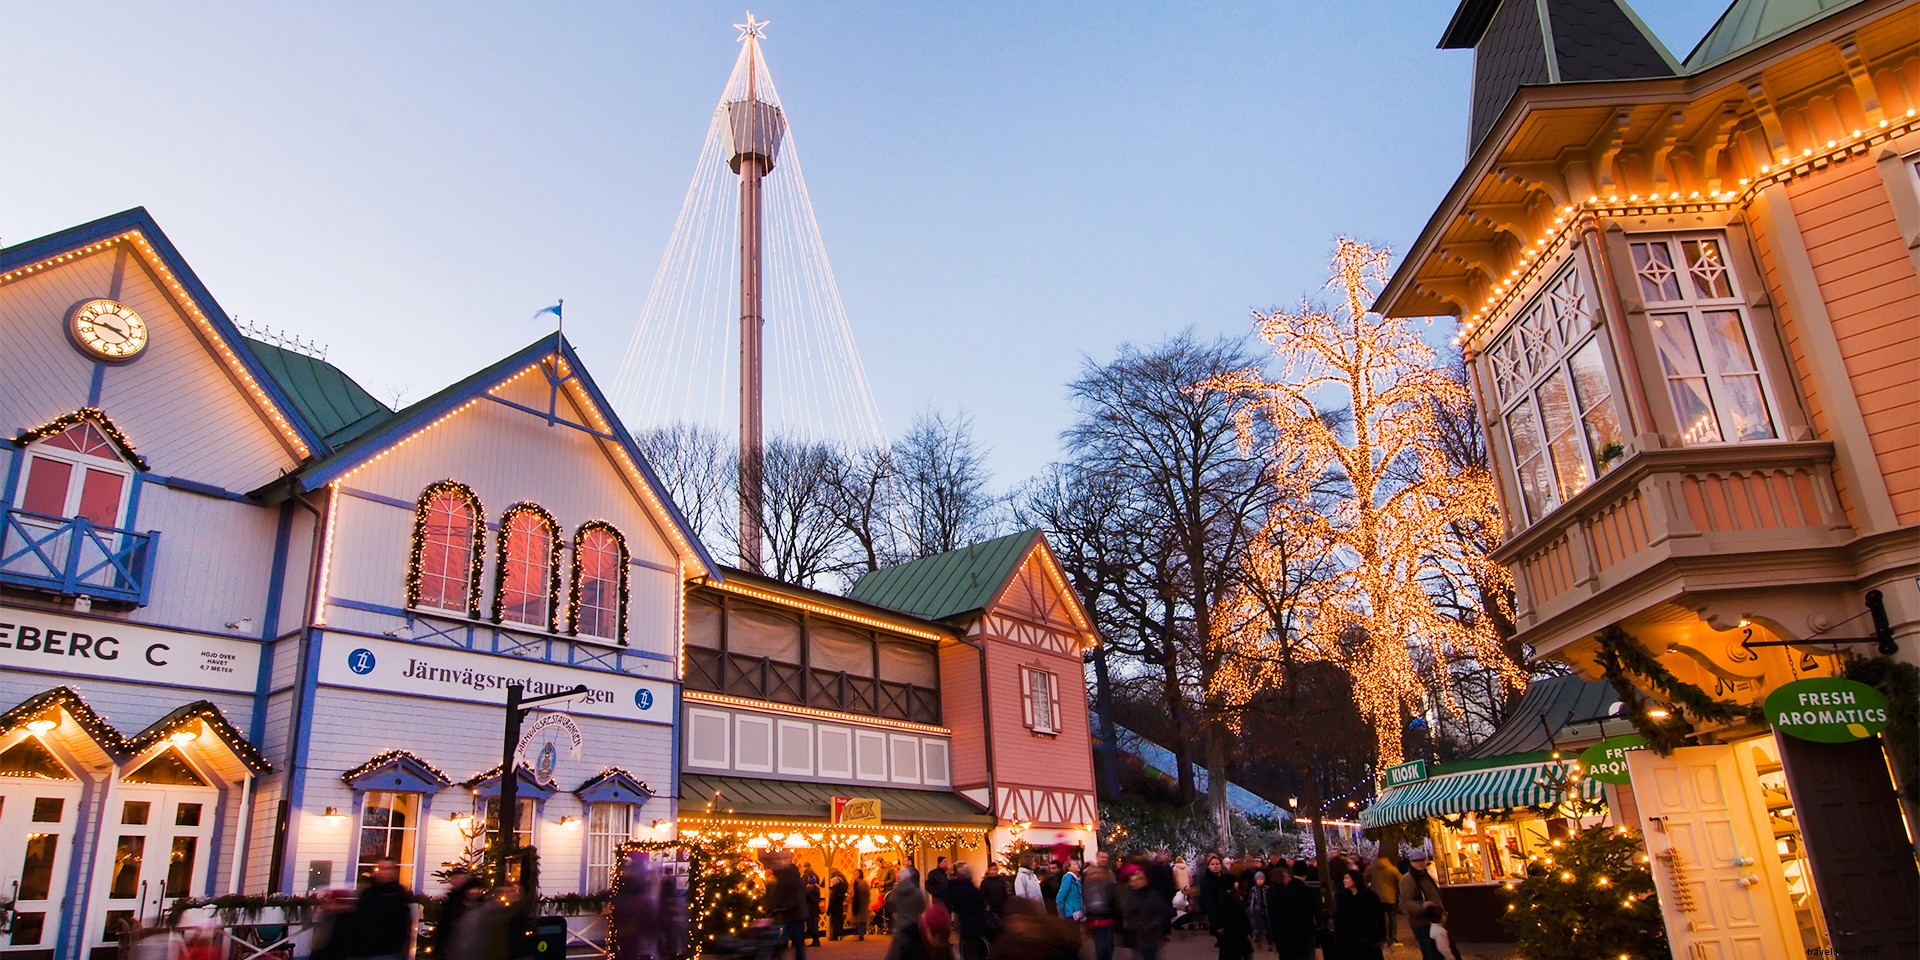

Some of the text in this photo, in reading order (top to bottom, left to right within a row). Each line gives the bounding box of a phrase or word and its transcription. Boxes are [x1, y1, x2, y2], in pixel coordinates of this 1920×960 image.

[145, 643, 170, 666] C
[211, 665, 234, 673] METER
[1798, 691, 1856, 706] FRESH
[1779, 708, 1887, 725] AROMATICS
[1391, 764, 1420, 783] KIOSK
[842, 801, 876, 821] KEX
